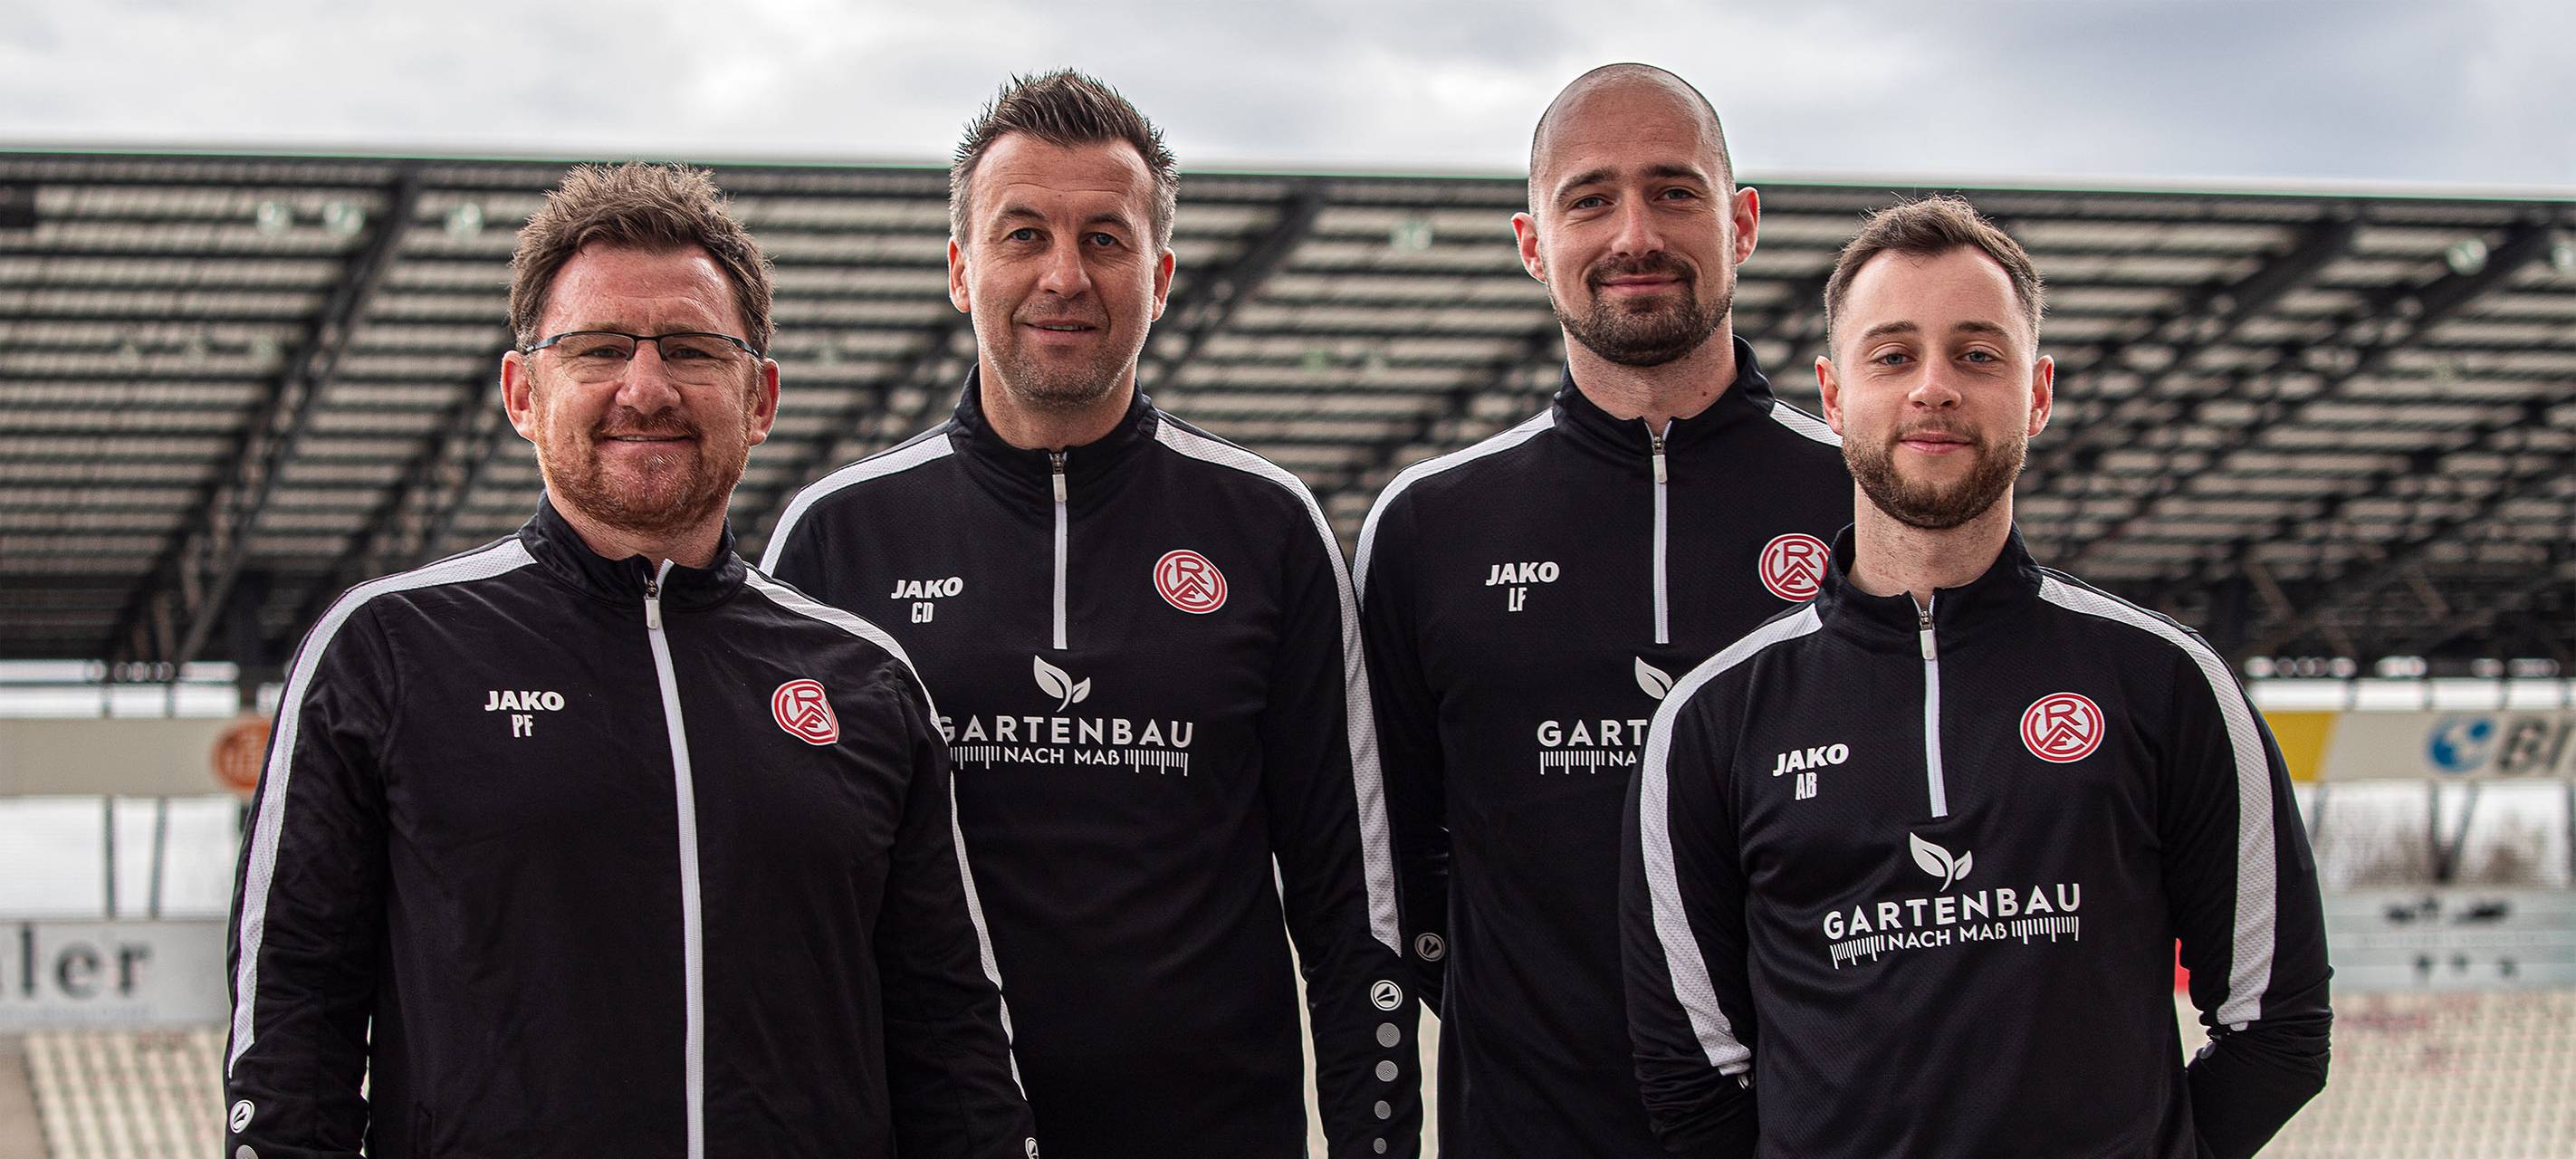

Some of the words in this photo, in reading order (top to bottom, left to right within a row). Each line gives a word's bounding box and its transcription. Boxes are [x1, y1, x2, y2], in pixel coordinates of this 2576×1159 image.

[1485, 560, 1560, 587] JAKO
[890, 576, 963, 599] JAKO
[1508, 587, 1527, 612] LF
[911, 601, 934, 624] CD
[484, 690, 565, 712] JAKO
[512, 714, 533, 738] PF
[1004, 746, 1065, 764] NACH
[1772, 742, 1850, 777] JAKO
[1795, 771, 1818, 800] AB
[1824, 883, 2080, 940] GARTENBAU
[1888, 926, 1951, 951] NACH
